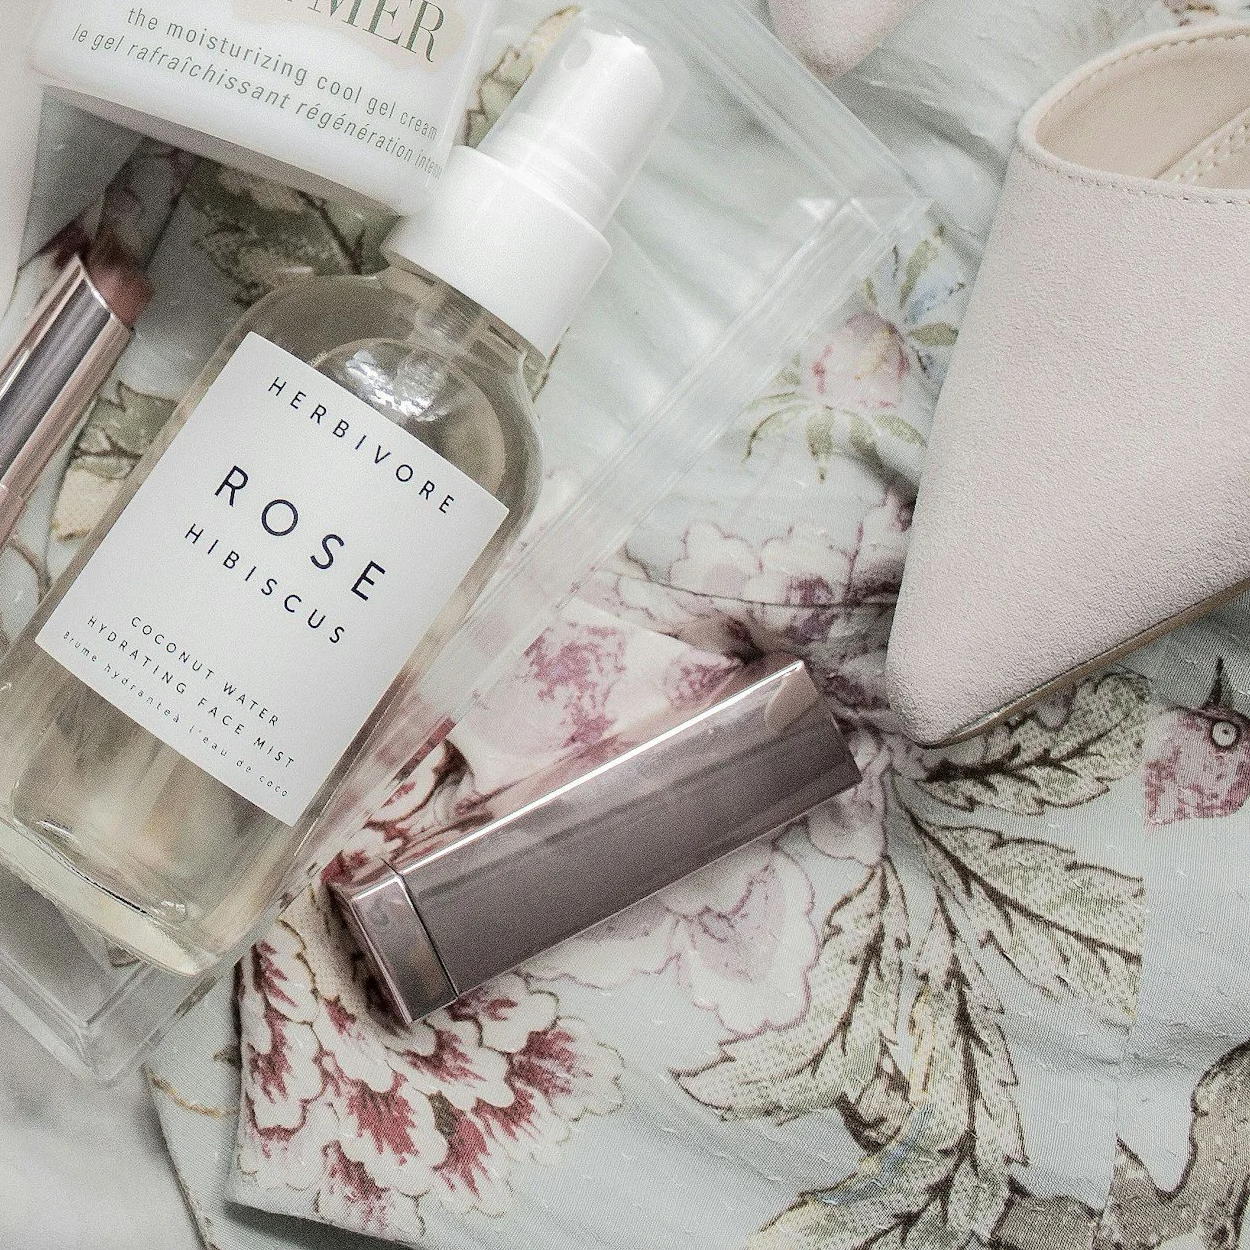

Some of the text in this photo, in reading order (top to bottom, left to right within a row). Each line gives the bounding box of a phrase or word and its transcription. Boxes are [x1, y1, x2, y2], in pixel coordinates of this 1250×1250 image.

[72, 23, 89, 43] le
[91, 34, 125, 51] gel
[127, 44, 291, 109] rafraîchissant
[295, 102, 414, 162] régénération
[127, 8, 438, 140] the moisturizing cool gel cream
[267, 376, 455, 514] HERBIVORE
[184, 522, 346, 644] HIBISCUS
[213, 464, 387, 602] ROSE
[62, 630, 98, 662] Brume
[235, 758, 252, 774] de
[258, 775, 289, 797] coco
[87, 615, 295, 768] HYDRATING FACE MIST
[131, 615, 279, 726] COCONUT WATER
